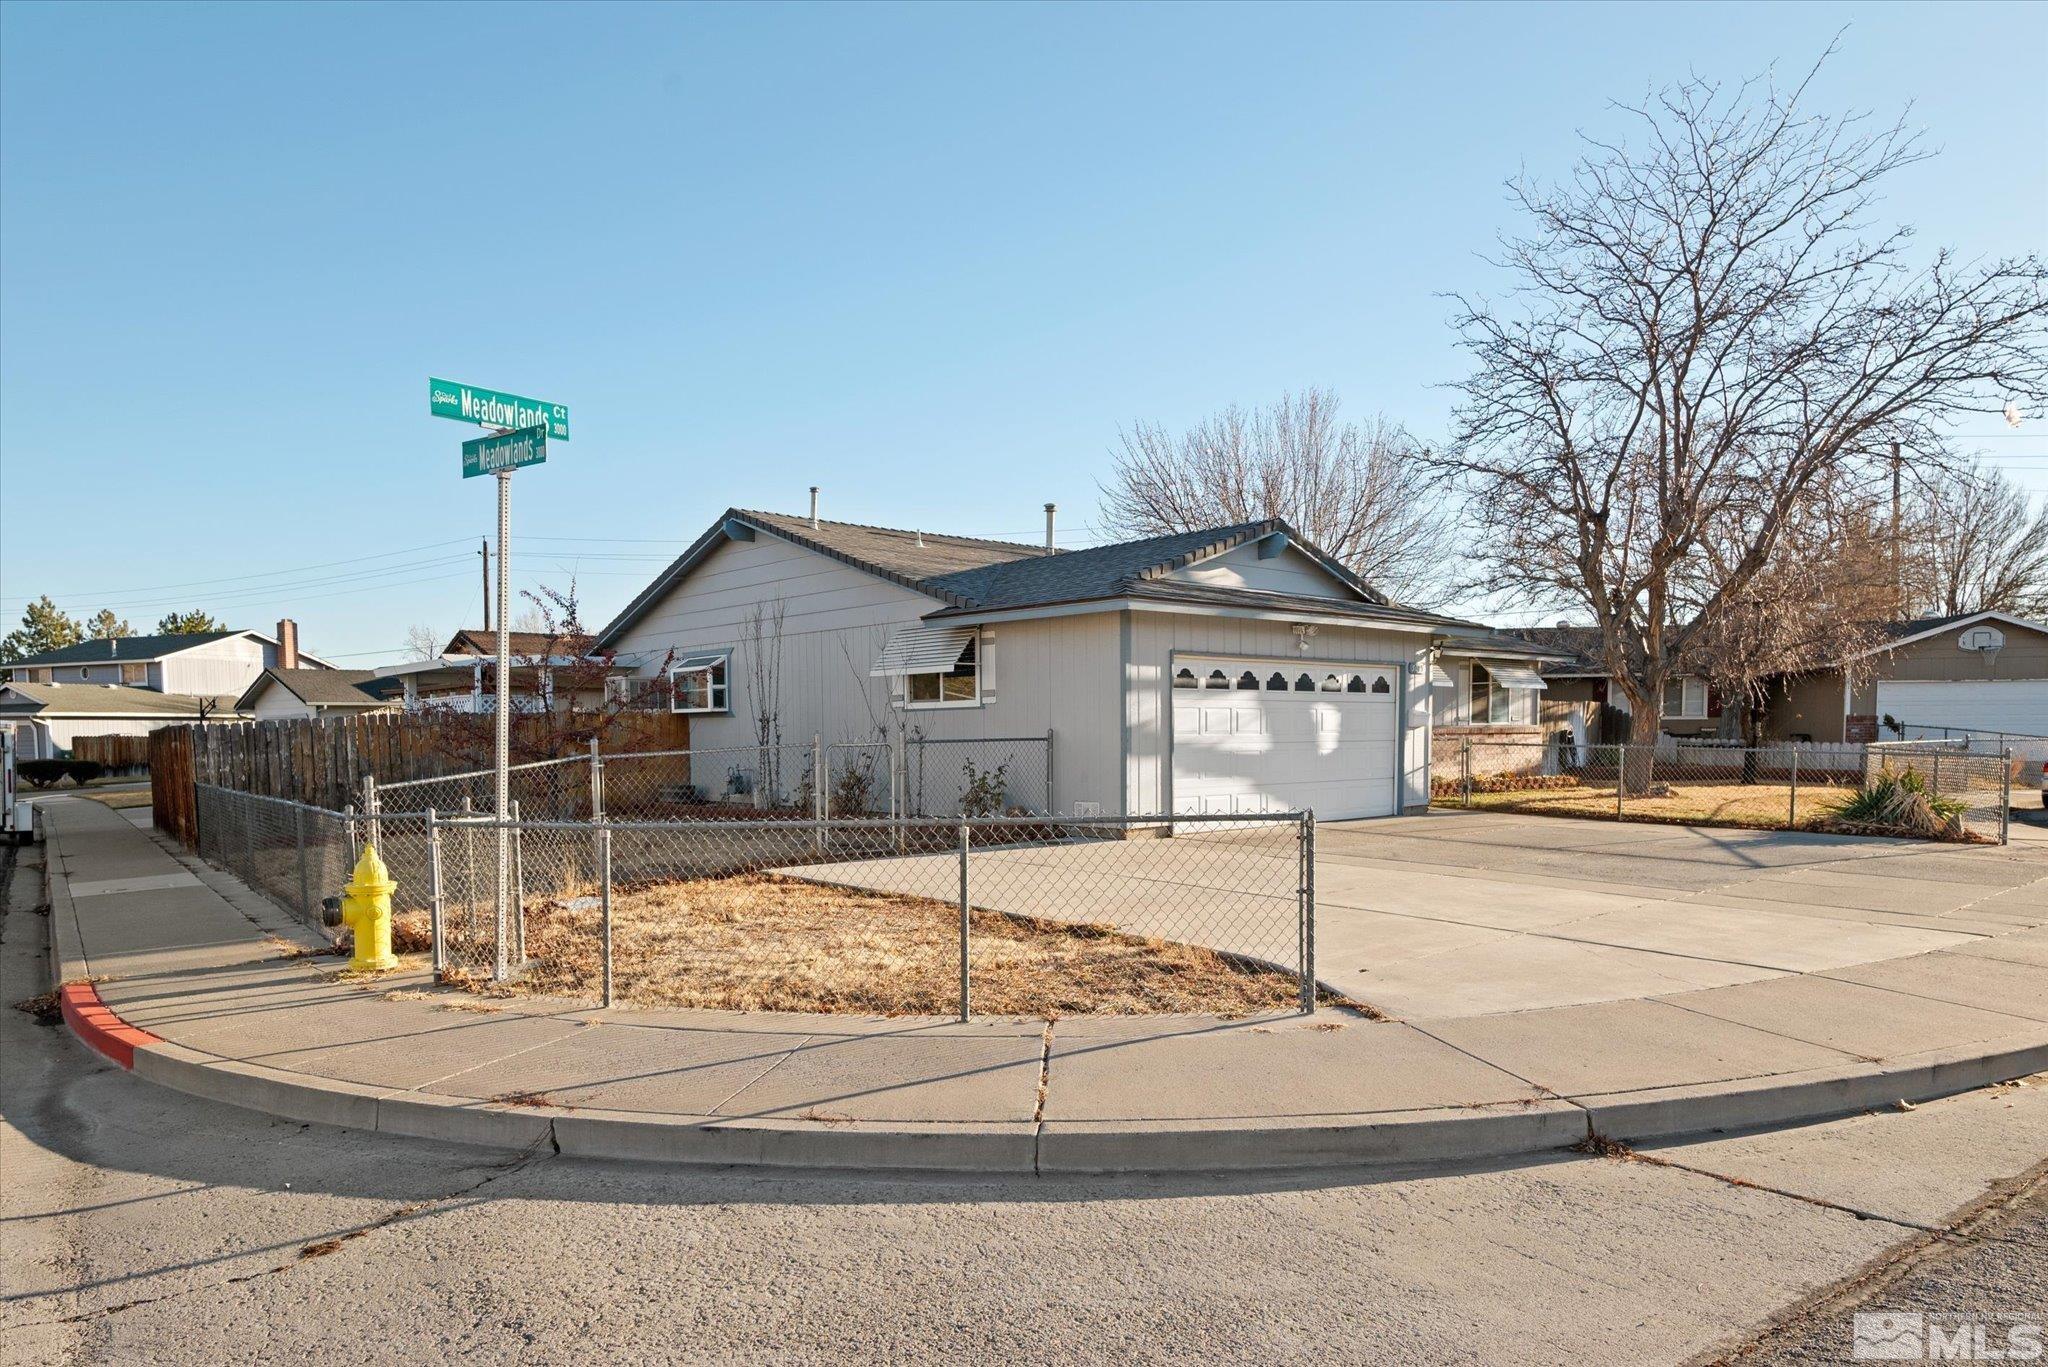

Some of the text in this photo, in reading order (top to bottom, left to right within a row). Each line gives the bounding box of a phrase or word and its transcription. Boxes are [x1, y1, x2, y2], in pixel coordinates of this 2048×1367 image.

[432, 388, 566, 431] Sparks Meadowlands Ct
[479, 435, 533, 471] Meadowlands
[536, 428, 545, 440] Dr
